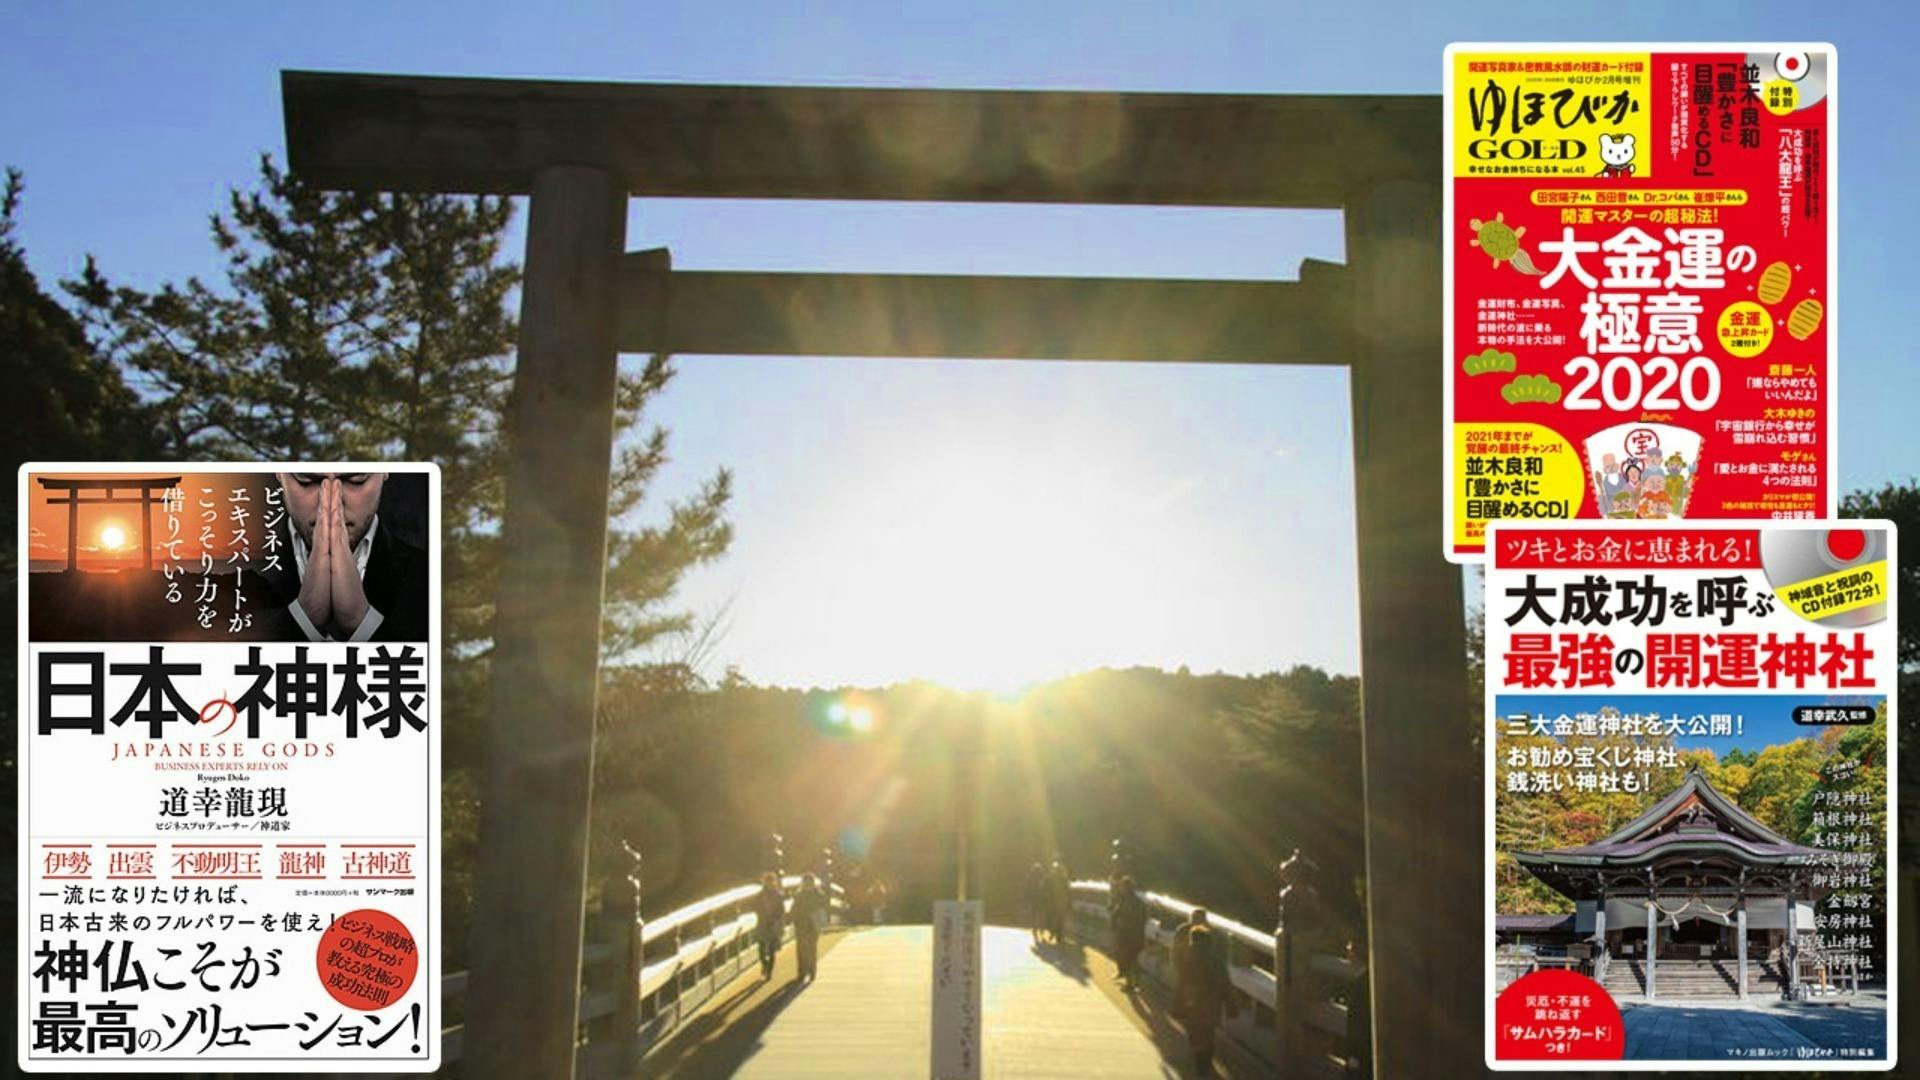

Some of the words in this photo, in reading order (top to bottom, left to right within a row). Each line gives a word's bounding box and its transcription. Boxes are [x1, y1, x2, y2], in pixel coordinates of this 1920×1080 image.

[1469, 79, 1639, 136] ゆほびか
[1717, 63, 1737, 143] 「豊かさに
[1739, 63, 1760, 149] 並木良和
[1469, 139, 1587, 159] GOLD
[1561, 208, 1718, 224] 開運マスターの超秘法！
[1538, 226, 1758, 290] 大金運の
[1579, 291, 1704, 355] 極意
[1730, 311, 1760, 326] 金運
[1563, 356, 1721, 411] 2020
[1466, 431, 1533, 442] 2021年までが
[1631, 433, 1652, 455] 宝
[1466, 457, 1543, 475] 並木良和
[1465, 478, 1540, 497] 「豊かさに
[1466, 500, 1568, 519] 目醒めるCD」
[262, 486, 286, 572] ビジネス
[161, 487, 186, 603] 借りている
[1507, 537, 1752, 562] ツキとお金に恵まれる！
[195, 487, 218, 629] こっそり力を
[228, 488, 252, 633] エキスパートが
[1505, 574, 1775, 628] 大成功を呼ぶ
[1503, 633, 1876, 688] 最強の開運神社
[38, 645, 428, 739] 日本の神様
[1507, 713, 1744, 737] 三大金運神社を大公開！
[111, 743, 245, 760] JAPANESE
[262, 742, 335, 758] GODS
[1507, 746, 1688, 769] お勧め宝くじ神社、
[154, 762, 200, 771] BUSINESS
[202, 762, 244, 771] EXPERTS
[246, 762, 271, 771] RELY
[272, 762, 289, 771] ON
[197, 774, 226, 783] Ryugen
[227, 774, 250, 782] Doko
[1507, 771, 1651, 794] 銭洗い神社も！
[159, 787, 289, 818] 道幸龍現
[1812, 811, 1873, 826] 箱根神社
[1812, 831, 1873, 847] 美保神社
[42, 852, 92, 874] 伊勢
[108, 852, 153, 874] 出雲
[171, 852, 262, 874] 不動明王
[278, 852, 326, 874] 龍神
[342, 852, 412, 874] 古神道
[38, 885, 250, 905] 一流になりたければ、
[38, 912, 337, 933] 日本古来のフルパワーを使え！
[1814, 913, 1873, 929] 安房神社
[340, 917, 416, 955] ビジネス戦略
[339, 937, 404, 967] の超プロが
[33, 940, 283, 993] 神仏こそが
[326, 950, 404, 989] 教える究極の
[326, 972, 391, 1006] 成功法則
[1535, 1008, 1581, 1020] 跳ね返す
[32, 1000, 421, 1055] 最高のソリューション！
[1503, 1023, 1612, 1042] 「サムハラカード」
[1545, 1042, 1571, 1053] つき！
